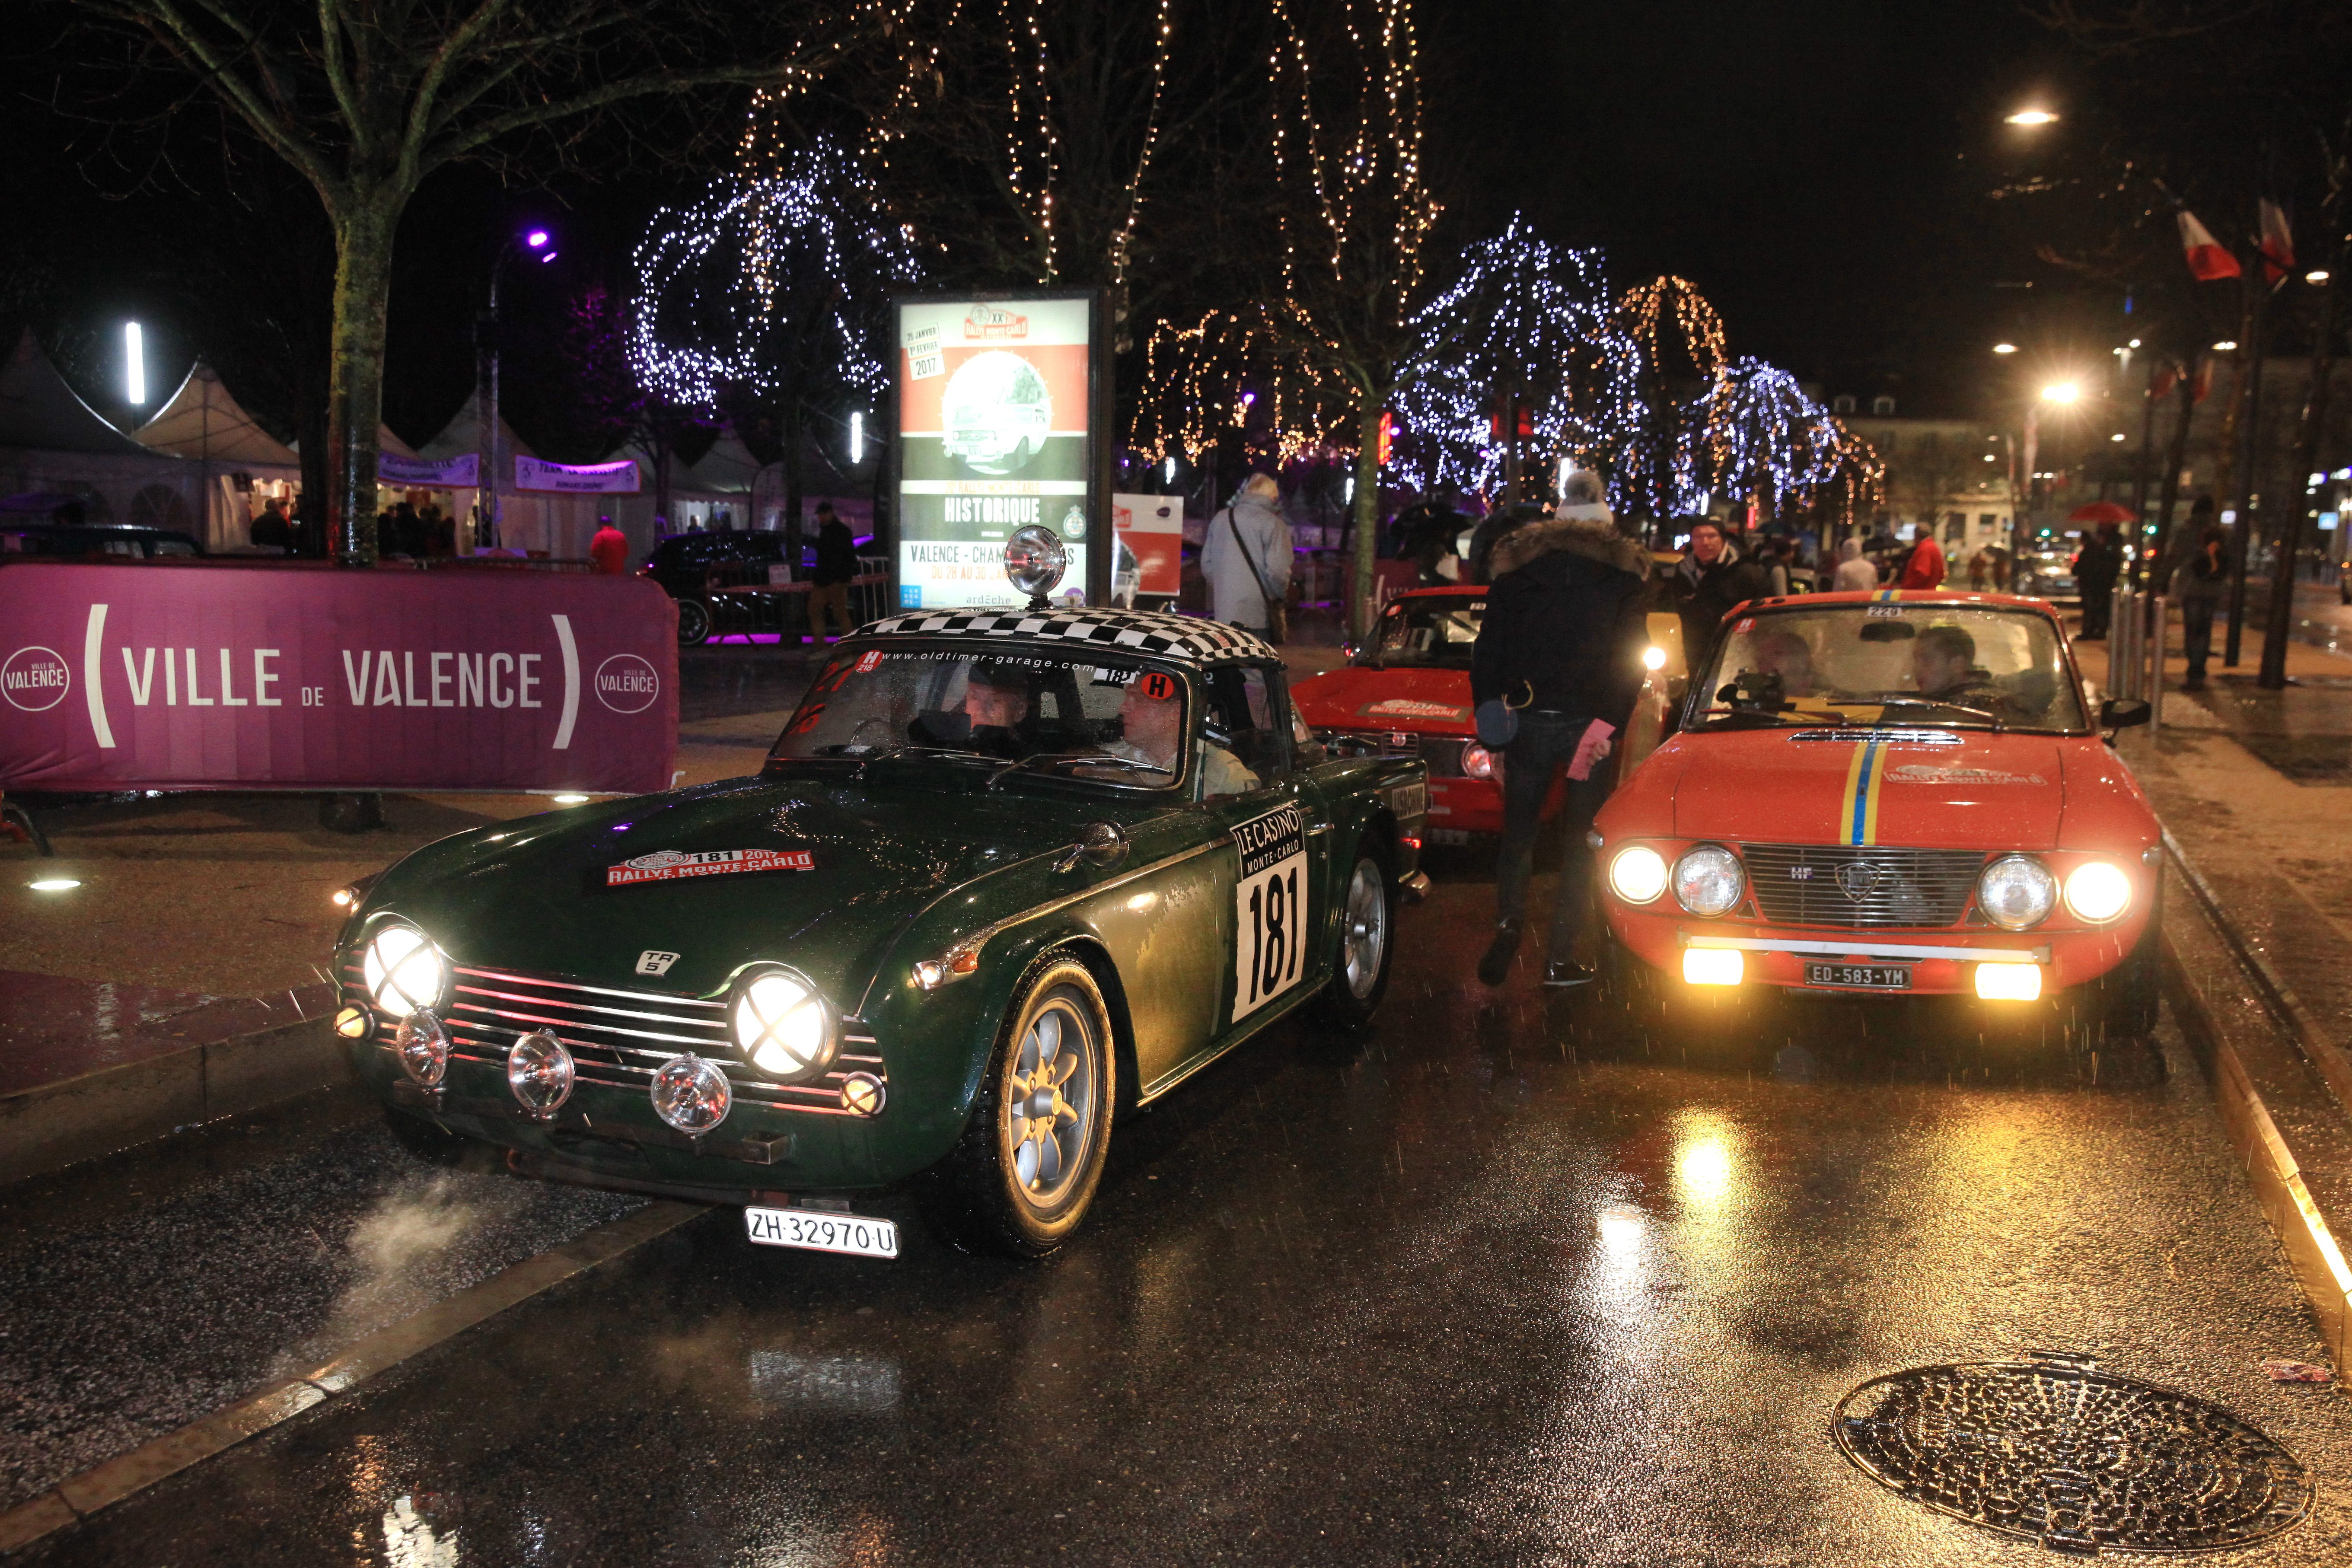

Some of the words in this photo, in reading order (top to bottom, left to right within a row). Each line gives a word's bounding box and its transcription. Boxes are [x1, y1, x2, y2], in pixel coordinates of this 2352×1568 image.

[915, 327, 937, 339] JANVIER
[916, 357, 936, 376] 2017
[959, 482, 985, 494] RALLYE
[945, 497, 1040, 526] HISTORIQUE
[911, 545, 959, 563] VALENCE
[932, 566, 943, 579] DU
[947, 566, 957, 579] 28
[961, 566, 972, 580] AU
[975, 566, 986, 580] 30
[864, 651, 880, 664] H
[882, 651, 1094, 672] www.oldtimer-garage.com
[6, 669, 64, 690] VALENCE
[121, 647, 282, 706] VILLE
[301, 687, 324, 706] DE
[342, 650, 542, 708] VALENCE
[600, 675, 654, 692] VALENCE
[1148, 675, 1167, 698] H
[1237, 828, 1254, 855] LE
[1253, 809, 1299, 848] CASINO
[693, 851, 735, 863] 181
[746, 850, 778, 860] 2017
[609, 869, 672, 883] RALLYE
[679, 854, 810, 874] MONTE-CARLO
[659, 867, 762, 880] HISTORIQUE
[1791, 867, 1813, 879] HF
[1249, 867, 1297, 1005] 181
[647, 952, 674, 962] TR
[645, 962, 659, 971] 5
[1813, 966, 1903, 984] ED-583-YM
